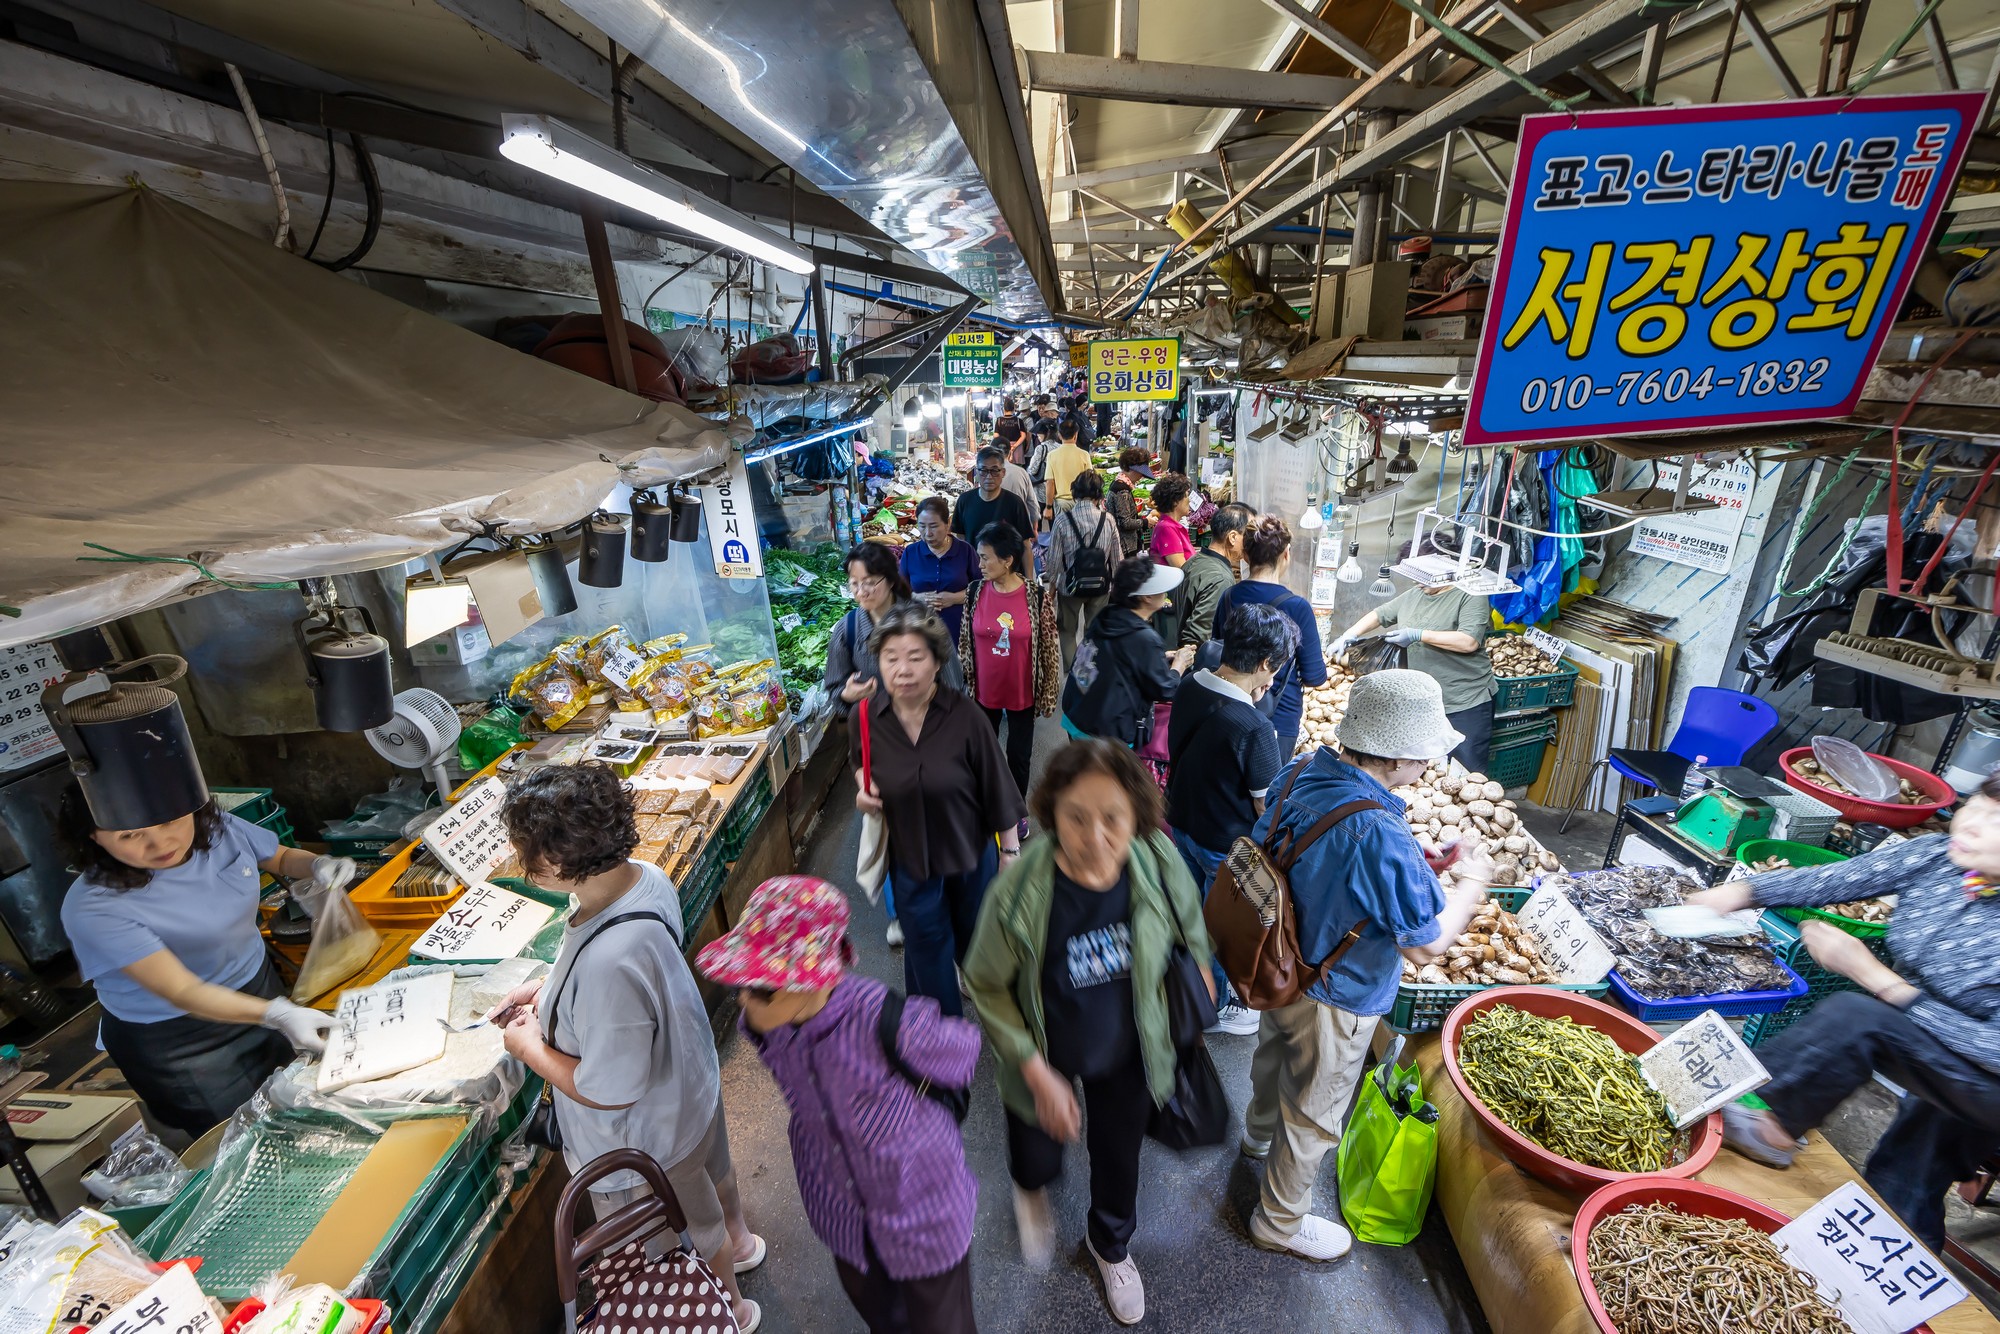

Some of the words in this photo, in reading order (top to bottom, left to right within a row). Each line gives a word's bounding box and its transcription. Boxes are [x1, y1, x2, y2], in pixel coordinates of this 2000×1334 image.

[1534, 136, 1900, 212] 표고·느타리·나물
[1890, 124, 1952, 211] 도매
[1502, 223, 1909, 360] 서경상회
[957, 334, 985, 345] 김서방
[947, 359, 999, 375] 대명농산
[1101, 346, 1168, 366] 연근·우엉
[1094, 369, 1174, 394] 용화상회
[1521, 358, 1830, 415] 010-7604-1832
[1668, 472, 1679, 481] 14
[1710, 478, 1720, 487] 17
[1723, 480, 1734, 489] 18
[1736, 482, 1747, 492] 19
[1728, 464, 1739, 472] 11
[1741, 465, 1750, 475] 12
[1717, 496, 1728, 506] 25
[1730, 499, 1742, 509] 26
[1639, 526, 1679, 541] 경동시장
[1679, 535, 1729, 554] 상인연합회
[14, 663, 29, 675] 16
[33, 657, 46, 668] 17
[6, 688, 23, 701] 22
[24, 682, 40, 694] 23
[15, 707, 31, 719] 29
[459, 797, 485, 820] 도토리
[481, 788, 497, 802] 묵
[1700, 1023, 1738, 1062] 양구
[1673, 1039, 1732, 1101] 시래기
[1835, 1198, 1949, 1301] 고사리
